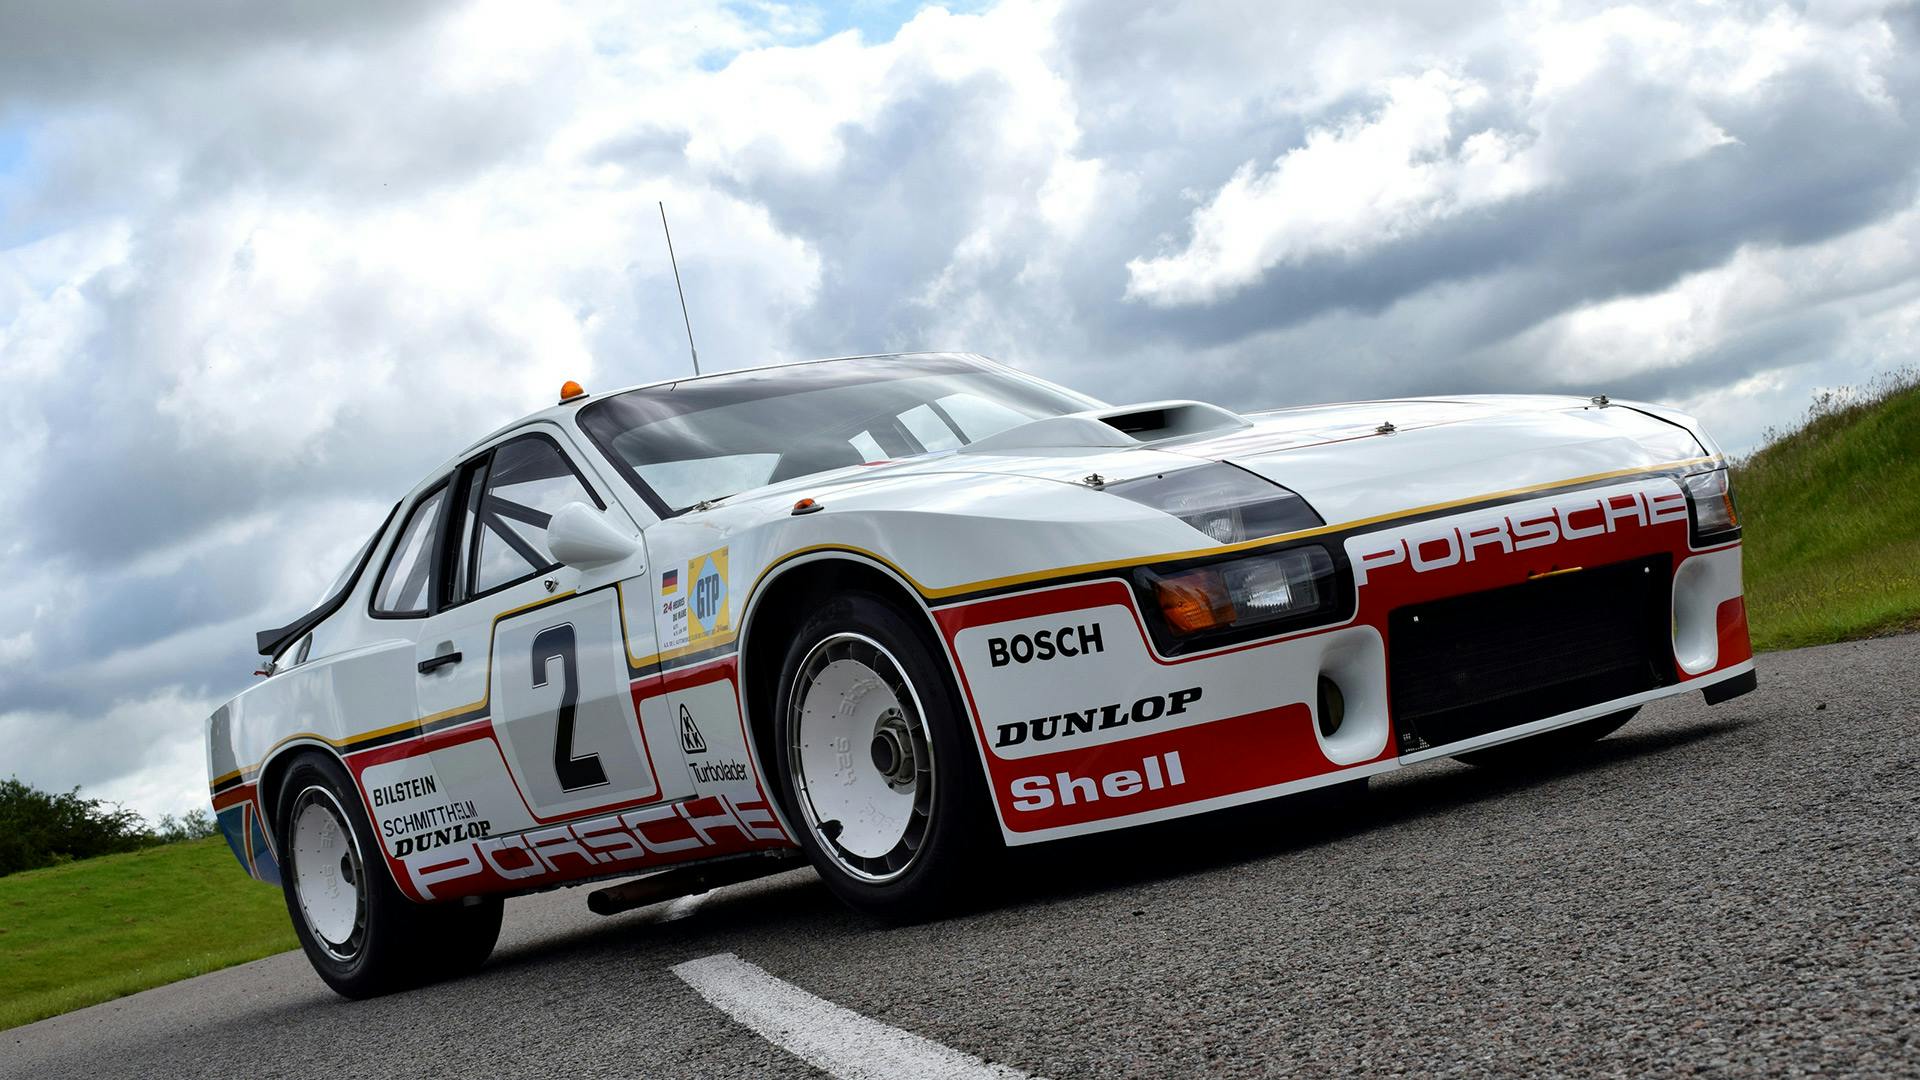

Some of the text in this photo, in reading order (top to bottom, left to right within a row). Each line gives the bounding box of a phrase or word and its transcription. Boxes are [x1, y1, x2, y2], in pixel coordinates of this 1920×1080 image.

[1346, 488, 1690, 586] PORSCHE
[663, 601, 673, 614] 24
[697, 573, 720, 620] GTP
[988, 622, 1105, 668] BOSCH
[531, 621, 611, 793] 2
[995, 687, 1203, 748] DUNLOP
[373, 775, 437, 808] BILSTEIN
[689, 758, 748, 784] Turbolader
[1010, 750, 1186, 812] Shell
[383, 800, 479, 838] SCHMITTHELM
[394, 820, 491, 859] DUNLOP
[403, 793, 787, 900] PORSCHE
